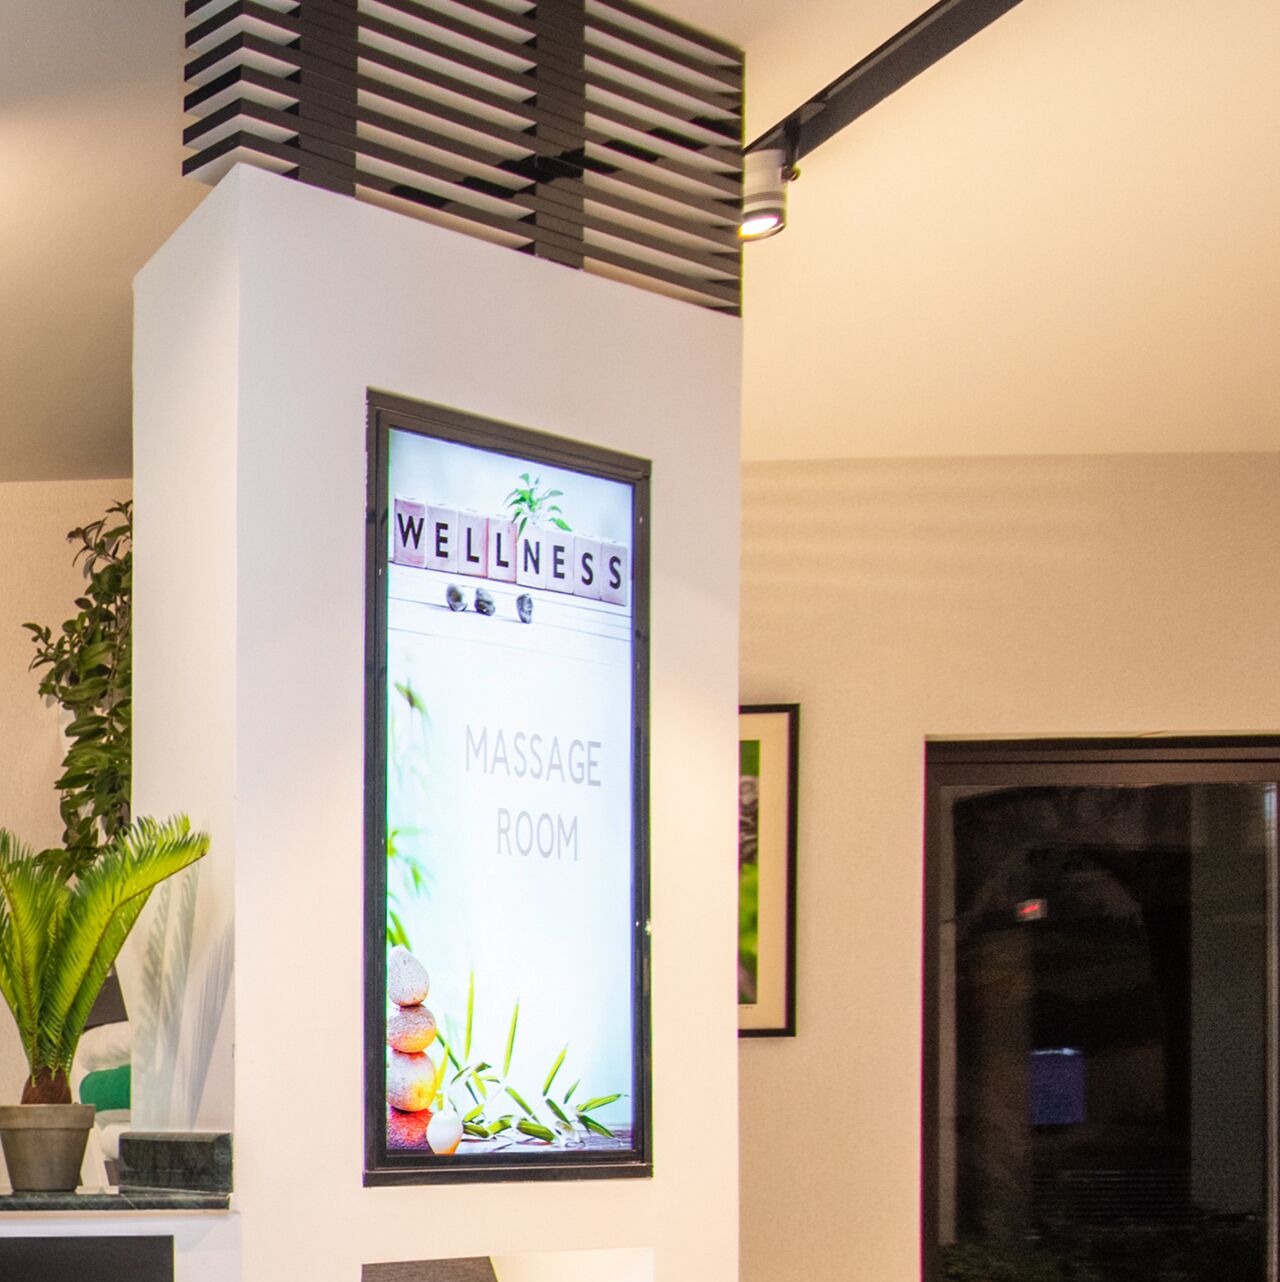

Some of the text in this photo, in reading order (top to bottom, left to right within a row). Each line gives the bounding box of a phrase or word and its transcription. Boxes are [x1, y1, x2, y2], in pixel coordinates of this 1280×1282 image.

[397, 513, 622, 590] WELLNESS
[465, 724, 601, 787] MASSAGE
[497, 807, 579, 861] ROOM
